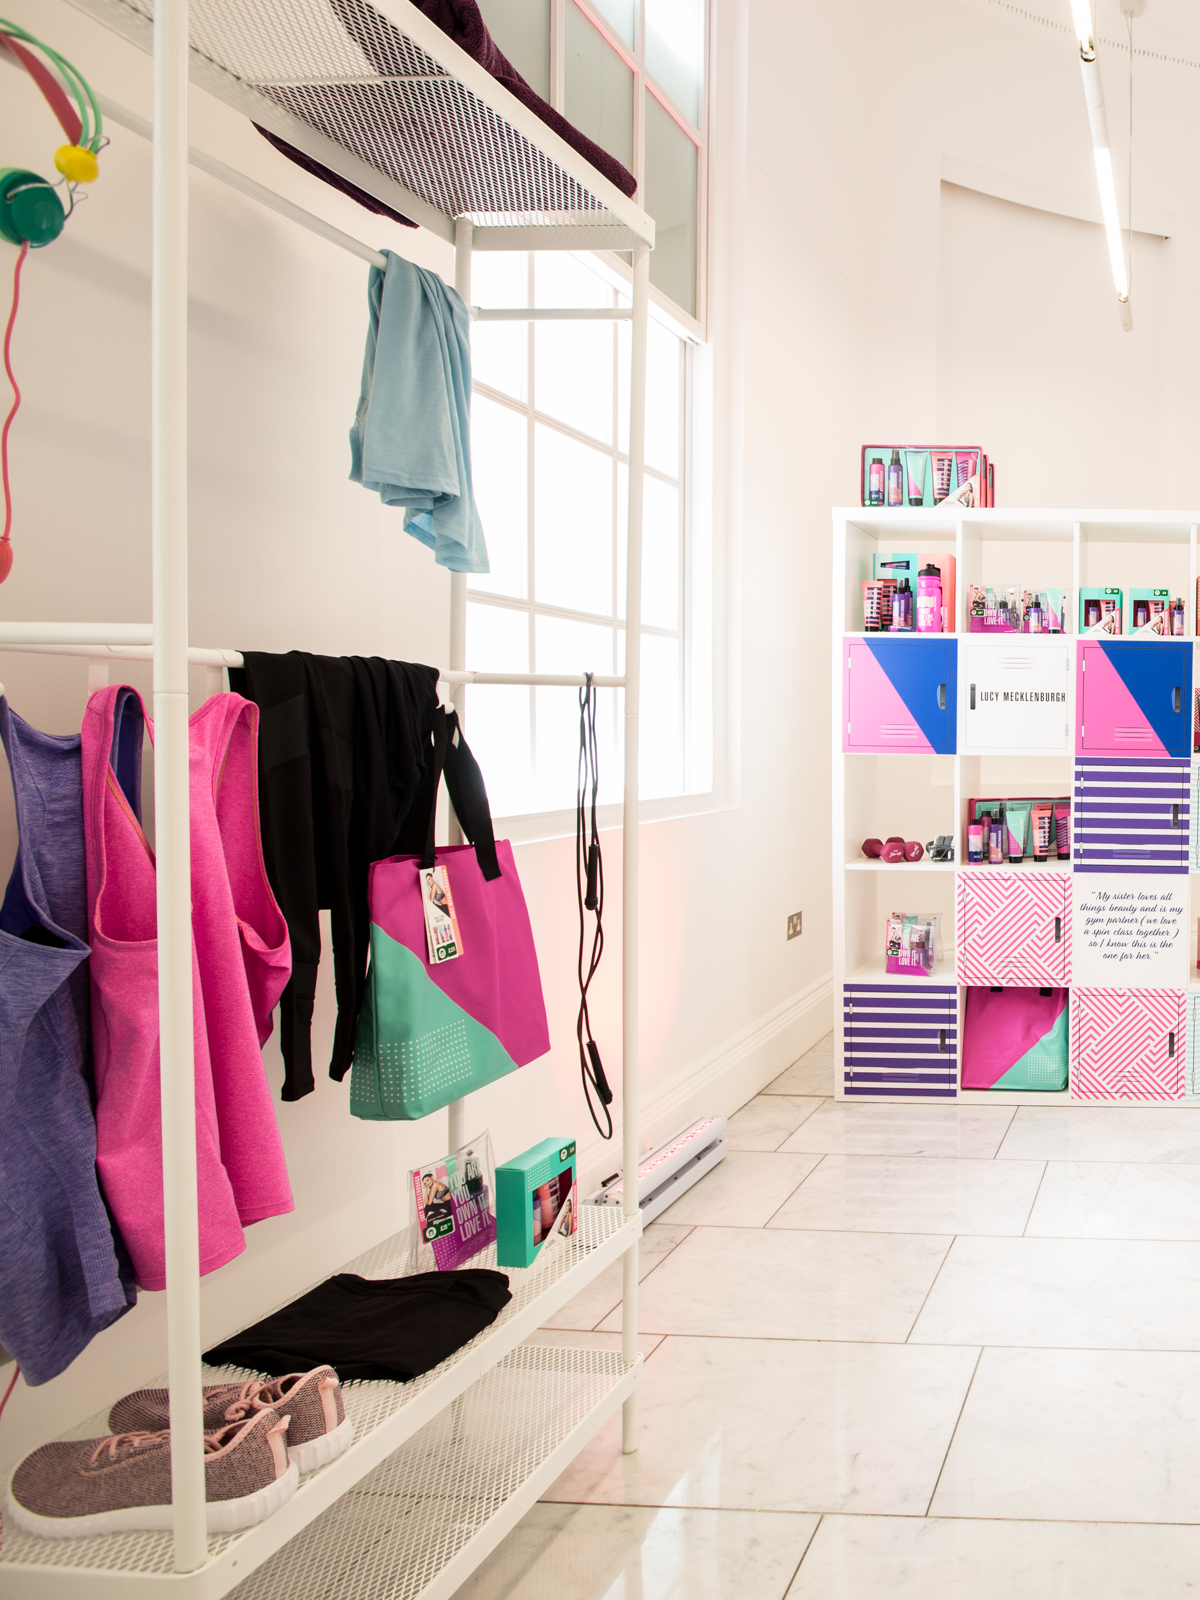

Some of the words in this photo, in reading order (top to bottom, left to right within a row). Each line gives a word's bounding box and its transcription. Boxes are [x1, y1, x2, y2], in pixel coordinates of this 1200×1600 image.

[980, 691, 999, 702] LUCY
[1003, 692, 1066, 702] MECKLENBURGH
[1080, 903, 1106, 914] things
[1109, 904, 1137, 914] beauty
[1140, 904, 1157, 912] and
[1084, 917, 1104, 925] gym
[1106, 916, 1139, 926] partner
[1092, 928, 1110, 937] spin
[1106, 939, 1130, 948] know
[1119, 951, 1134, 962] for
[456, 1199, 478, 1224] OWN
[460, 1215, 482, 1241] LOVE
